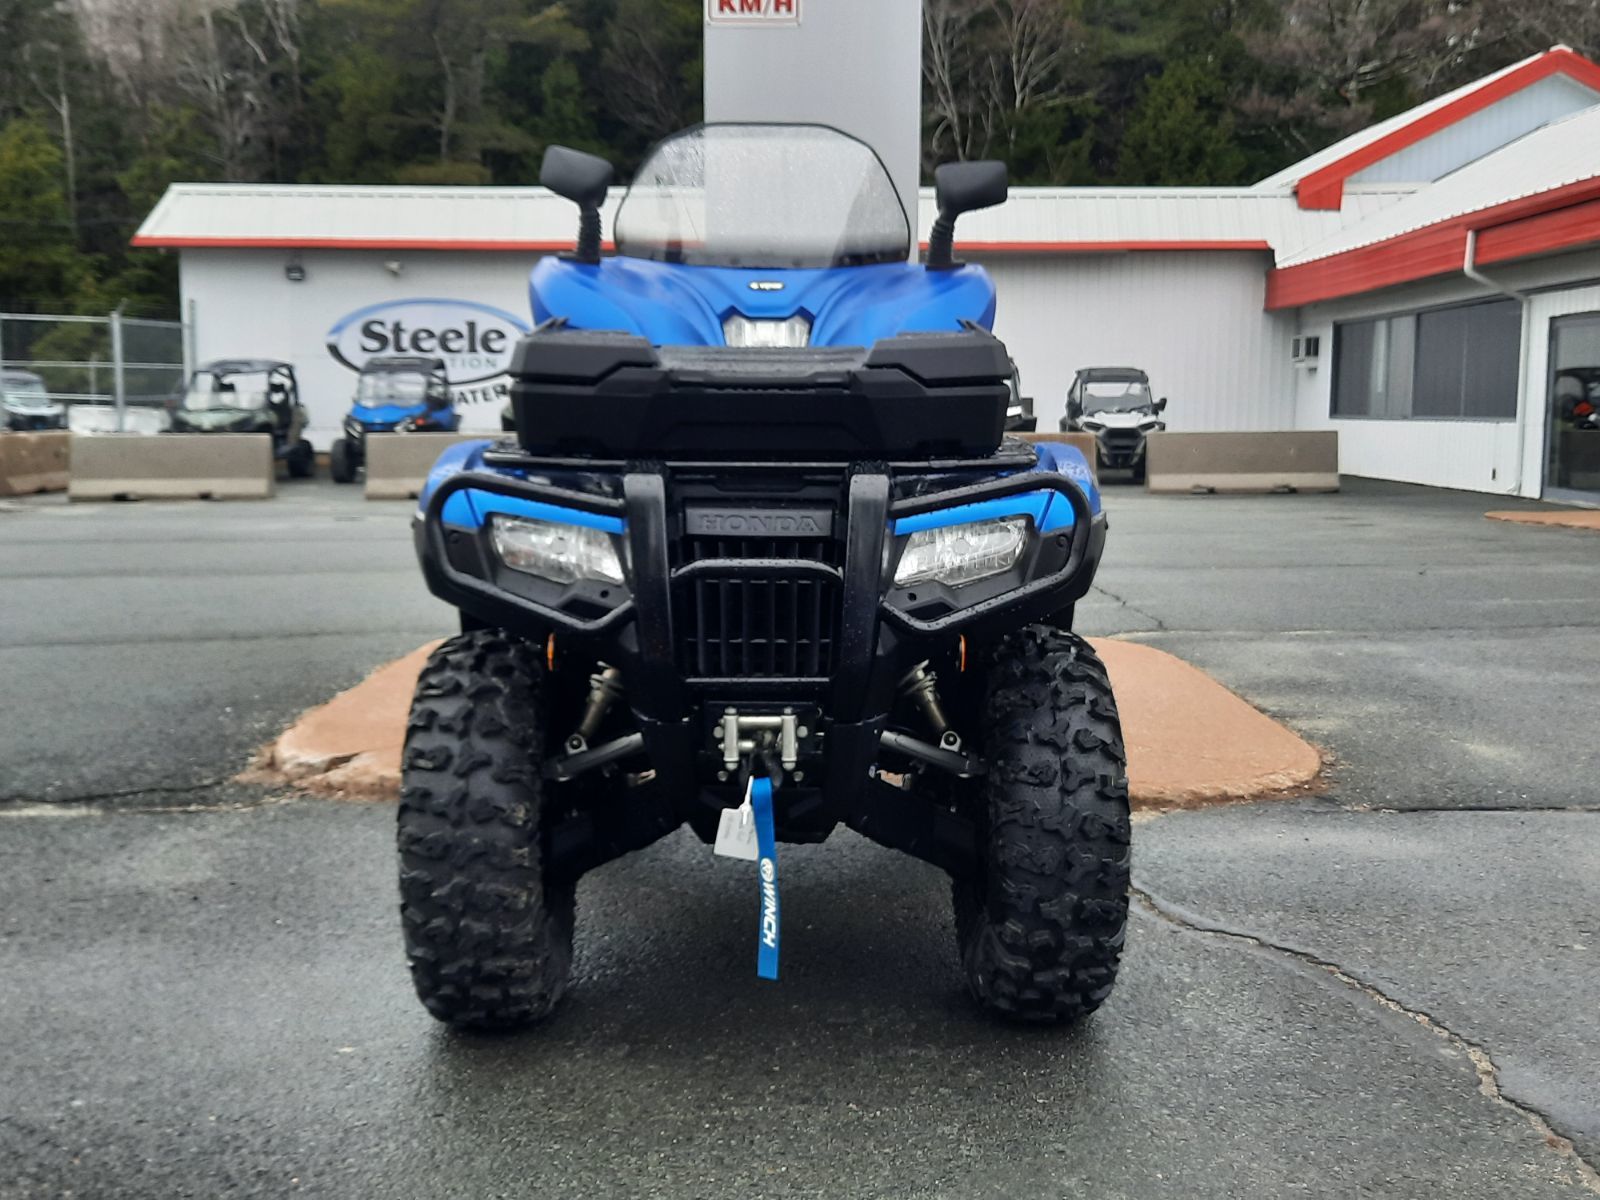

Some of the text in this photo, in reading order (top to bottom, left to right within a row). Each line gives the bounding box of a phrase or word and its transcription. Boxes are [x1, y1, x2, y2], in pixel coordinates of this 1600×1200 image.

[718, 0, 793, 15] KM/H
[360, 319, 507, 354] Steele
[700, 514, 822, 533] HONDA
[762, 882, 777, 949] WINCH
